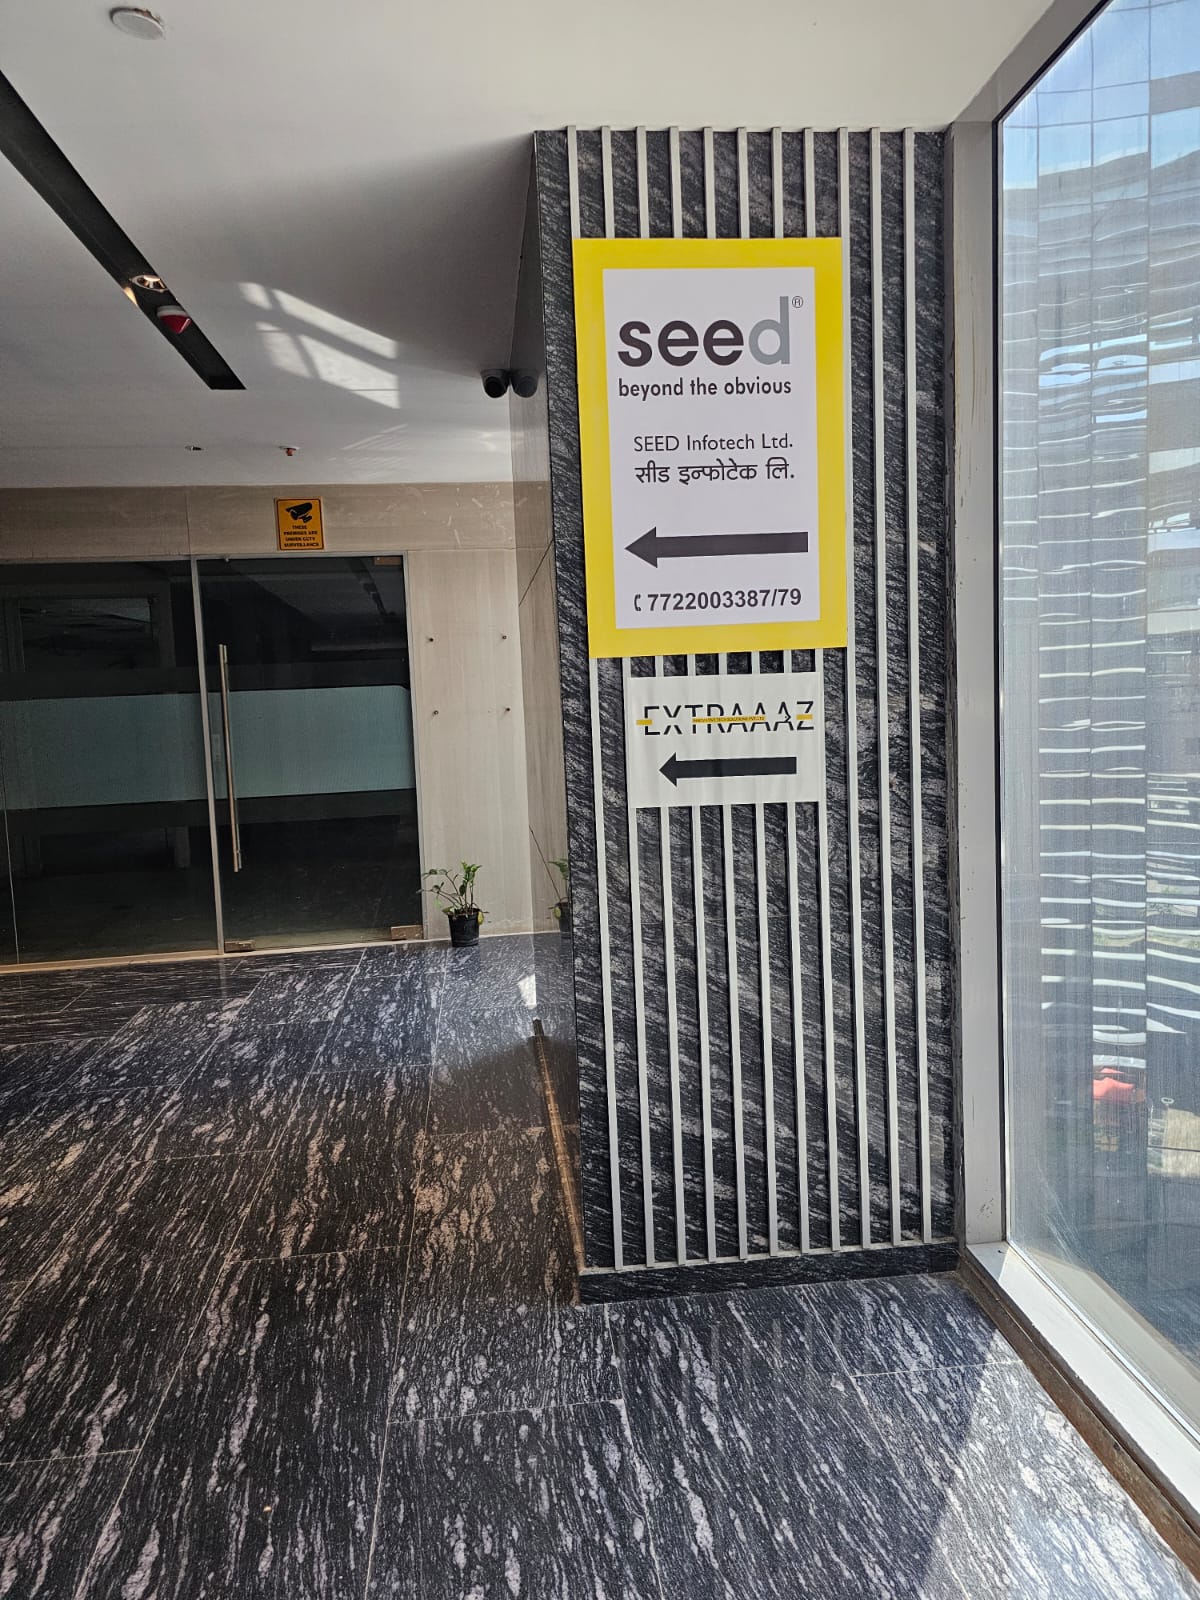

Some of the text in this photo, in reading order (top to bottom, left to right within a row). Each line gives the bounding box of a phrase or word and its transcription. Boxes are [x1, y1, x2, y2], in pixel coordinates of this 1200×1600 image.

[617, 295, 790, 367] seed
[618, 376, 792, 401] beyond the obvious
[633, 432, 793, 451] SEED Infotech Ltd.
[634, 456, 795, 486] सीड इन्फोटेक लि.
[647, 588, 802, 611] 7722003387/79
[636, 701, 815, 736] EXTRAAAZ
